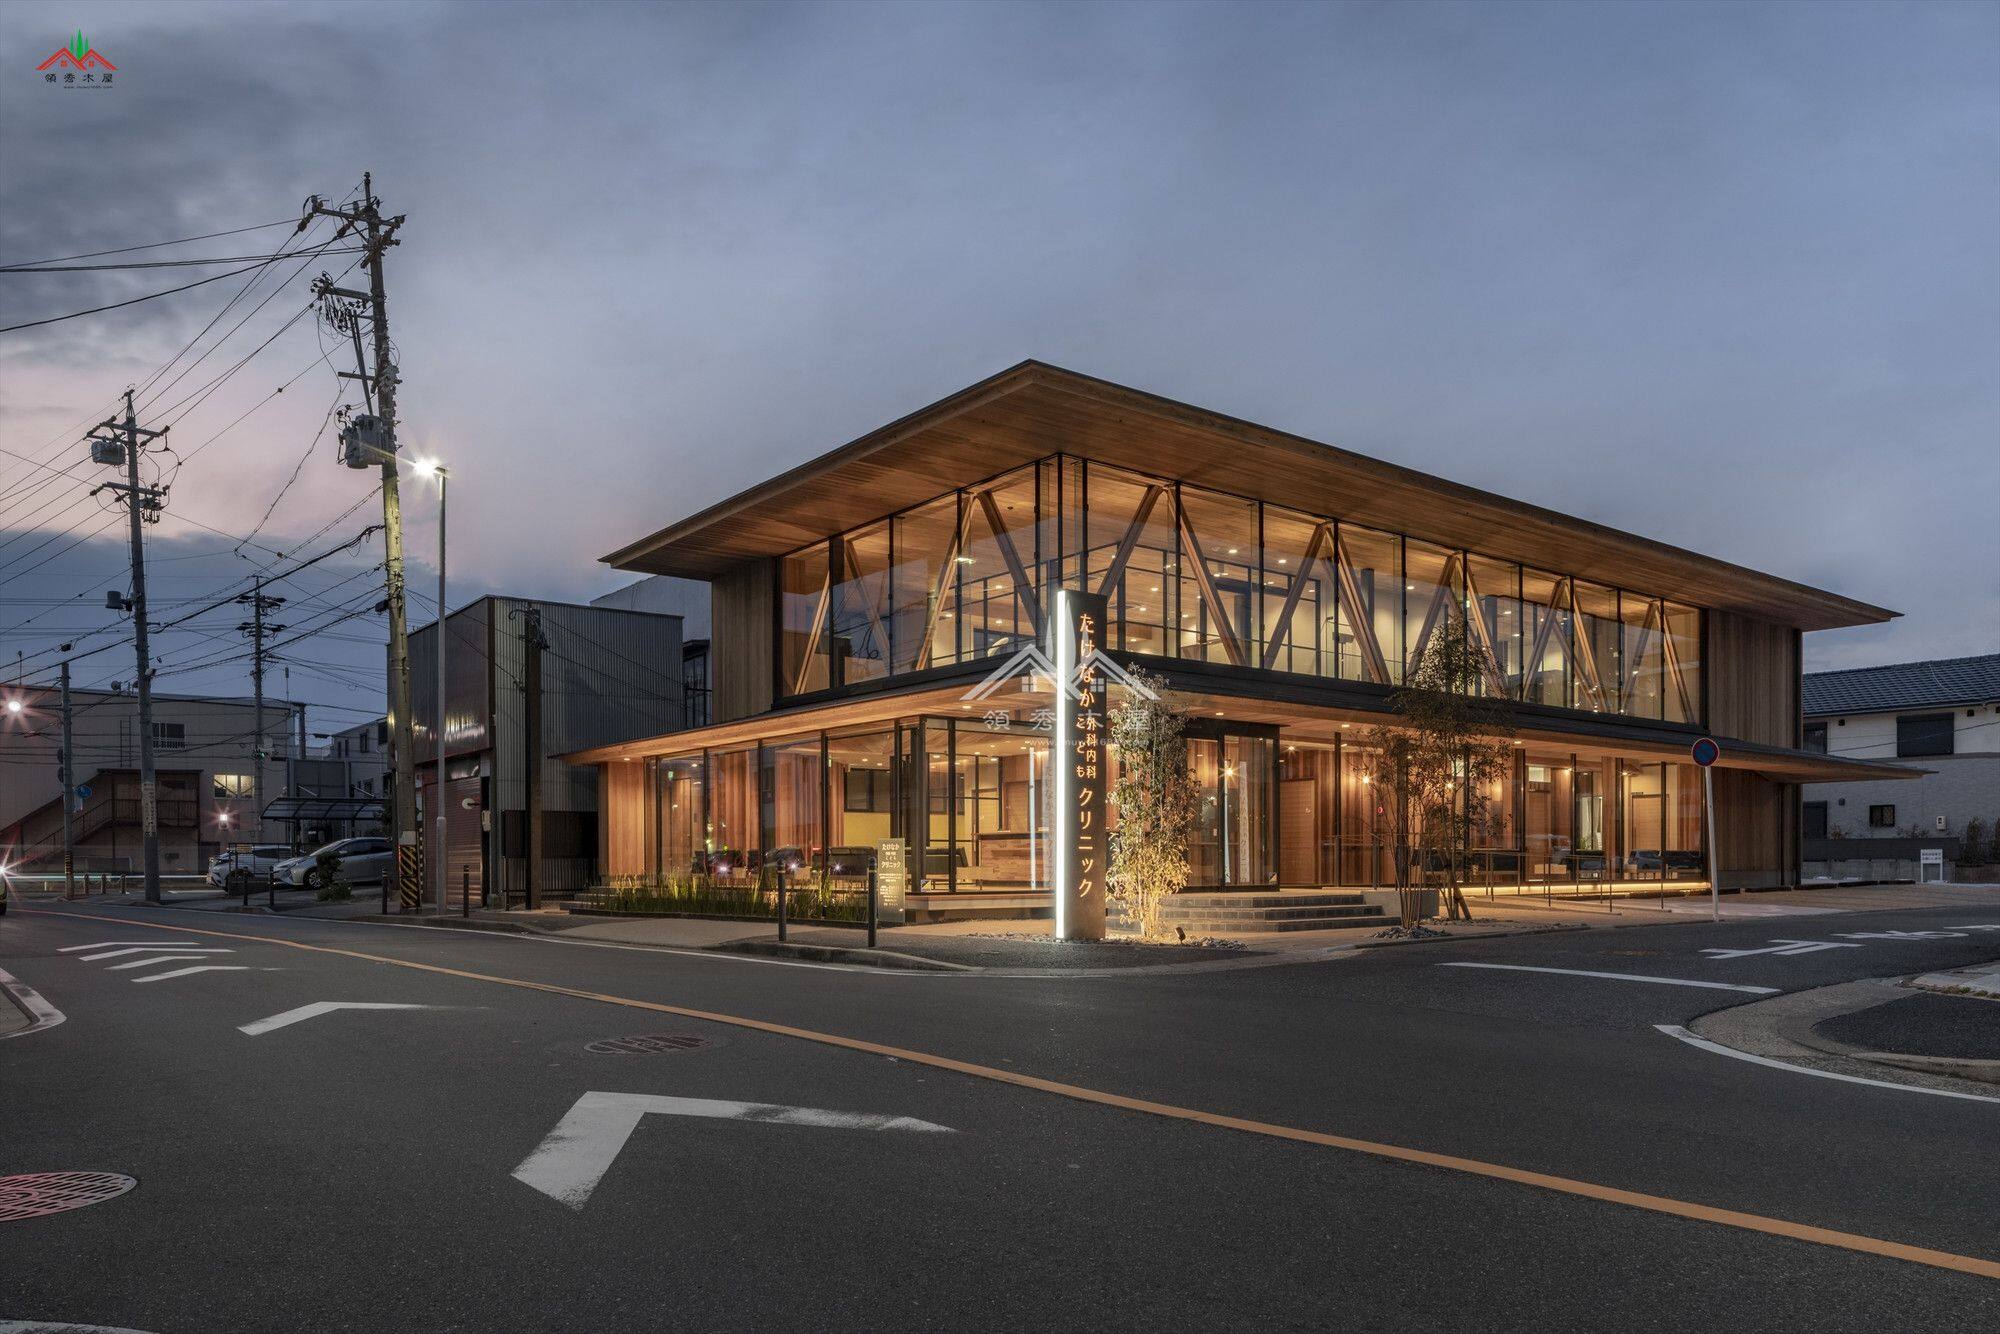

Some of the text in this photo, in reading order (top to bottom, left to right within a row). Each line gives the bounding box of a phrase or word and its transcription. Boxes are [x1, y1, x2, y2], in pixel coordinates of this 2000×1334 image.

[1079, 613, 1095, 708] たけなか
[1075, 717, 1087, 779] こども
[1086, 717, 1097, 780] 外科内科
[1078, 787, 1094, 899] クリニック
